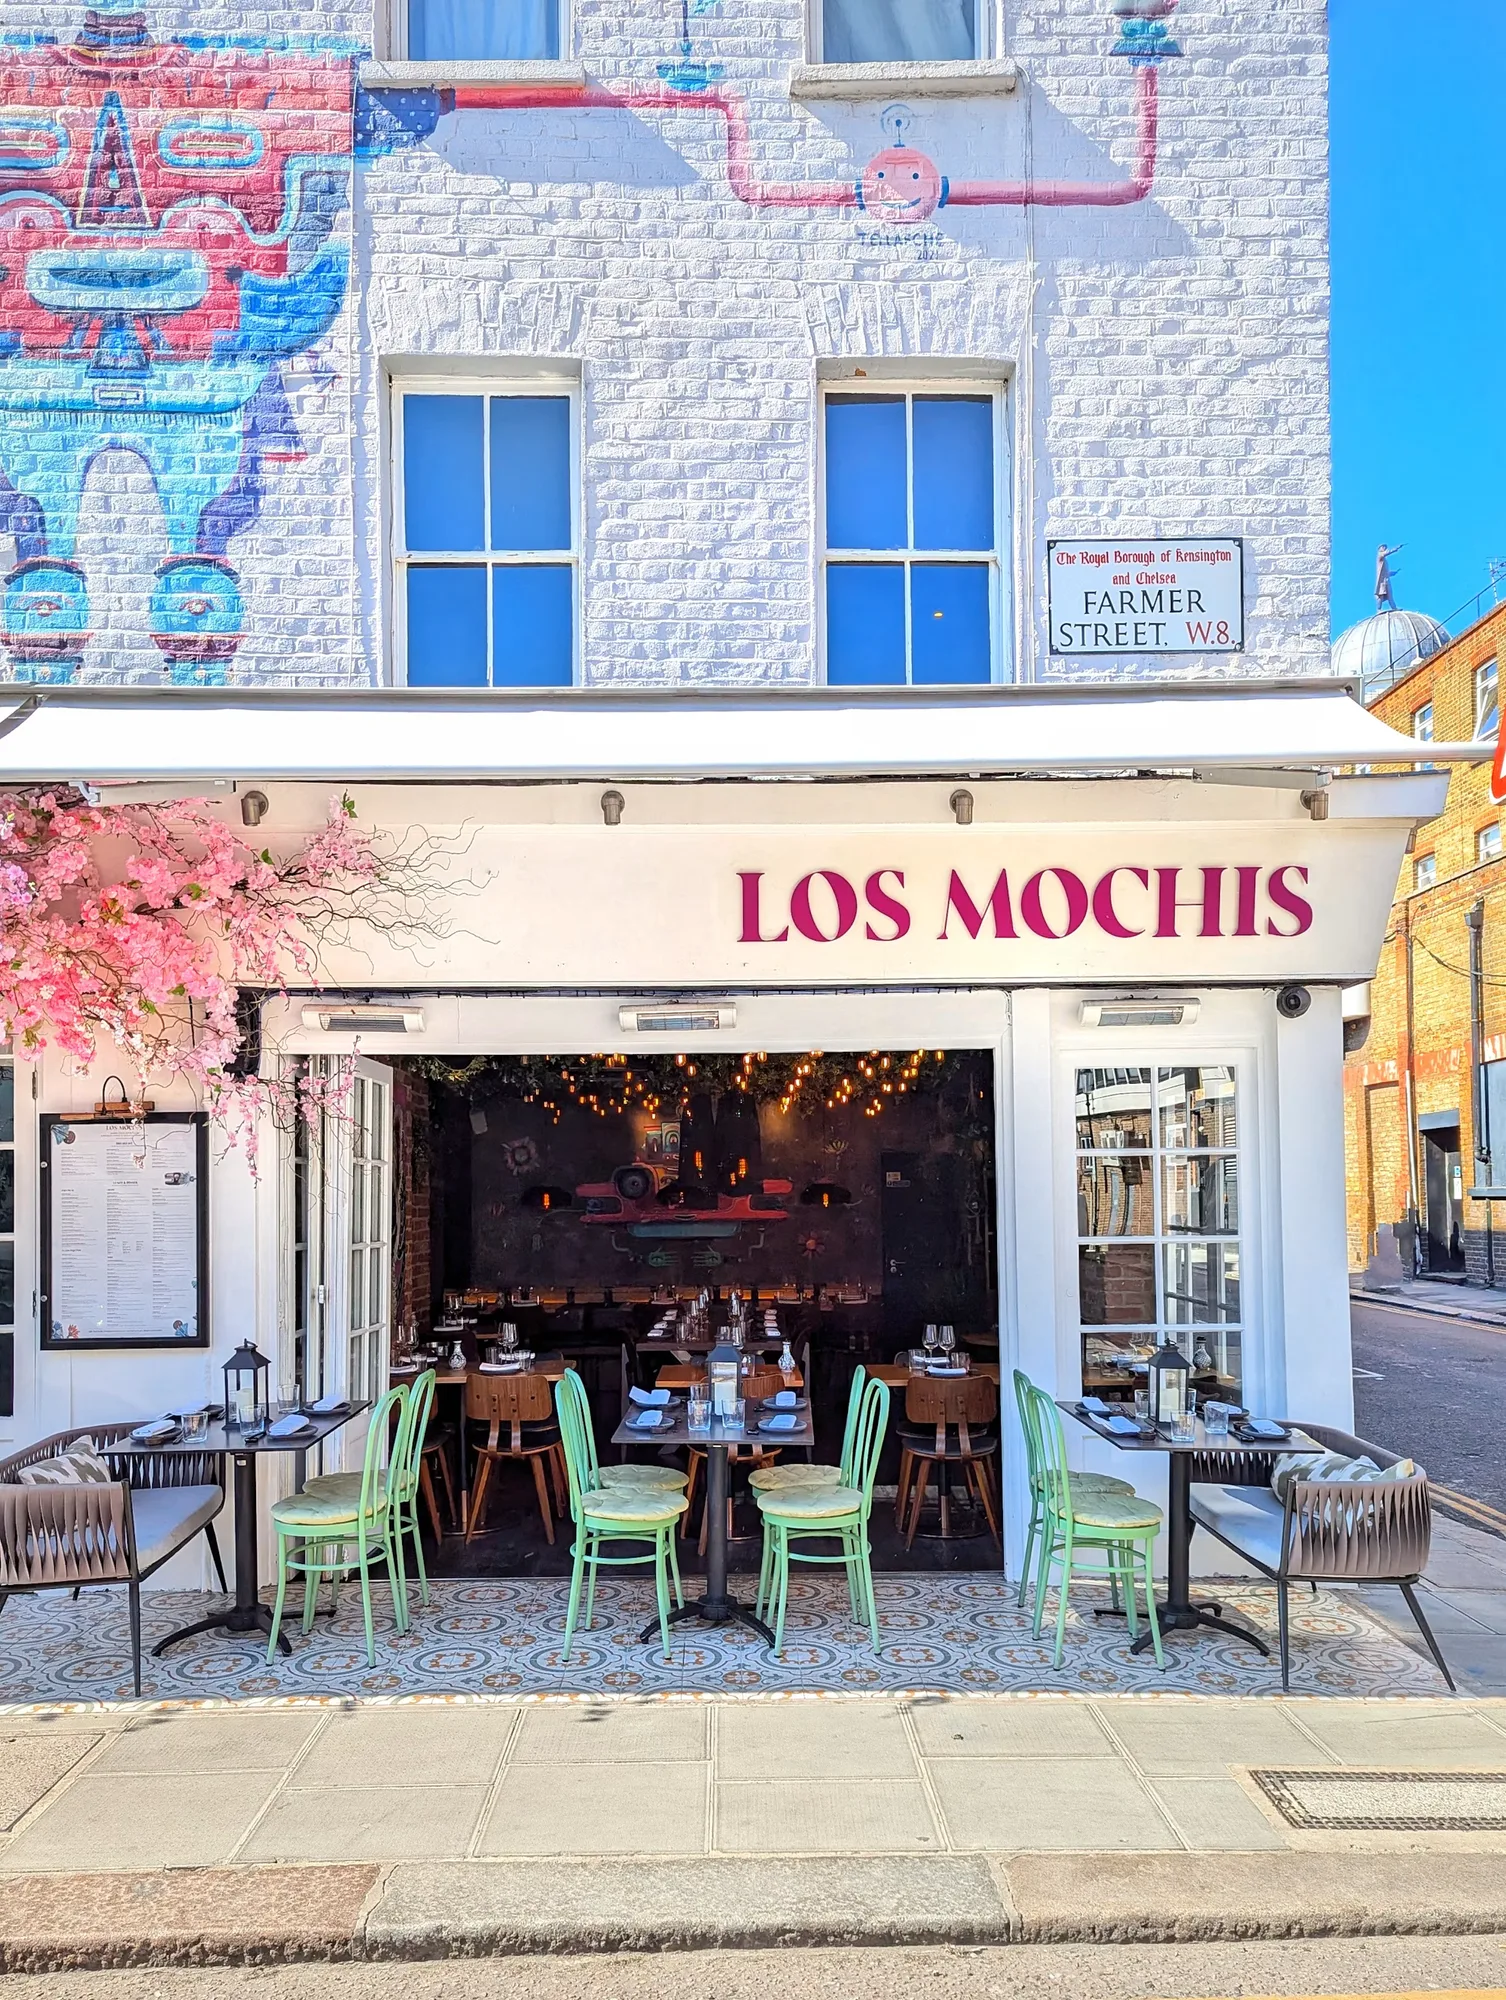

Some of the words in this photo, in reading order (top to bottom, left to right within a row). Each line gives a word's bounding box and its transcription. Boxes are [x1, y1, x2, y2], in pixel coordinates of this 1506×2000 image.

[1056, 552, 1077, 565] The
[1079, 551, 1109, 568] Royal
[1114, 550, 1155, 566] Borough
[1160, 549, 1171, 562] of
[1176, 548, 1232, 565] Kensington
[1112, 572, 1130, 585] and
[1136, 571, 1176, 585] Chelsea
[1084, 589, 1206, 614] FARMER
[1185, 620, 1236, 645] W.8.
[736, 870, 911, 942] LOS
[936, 865, 1314, 940] MOCHIS
